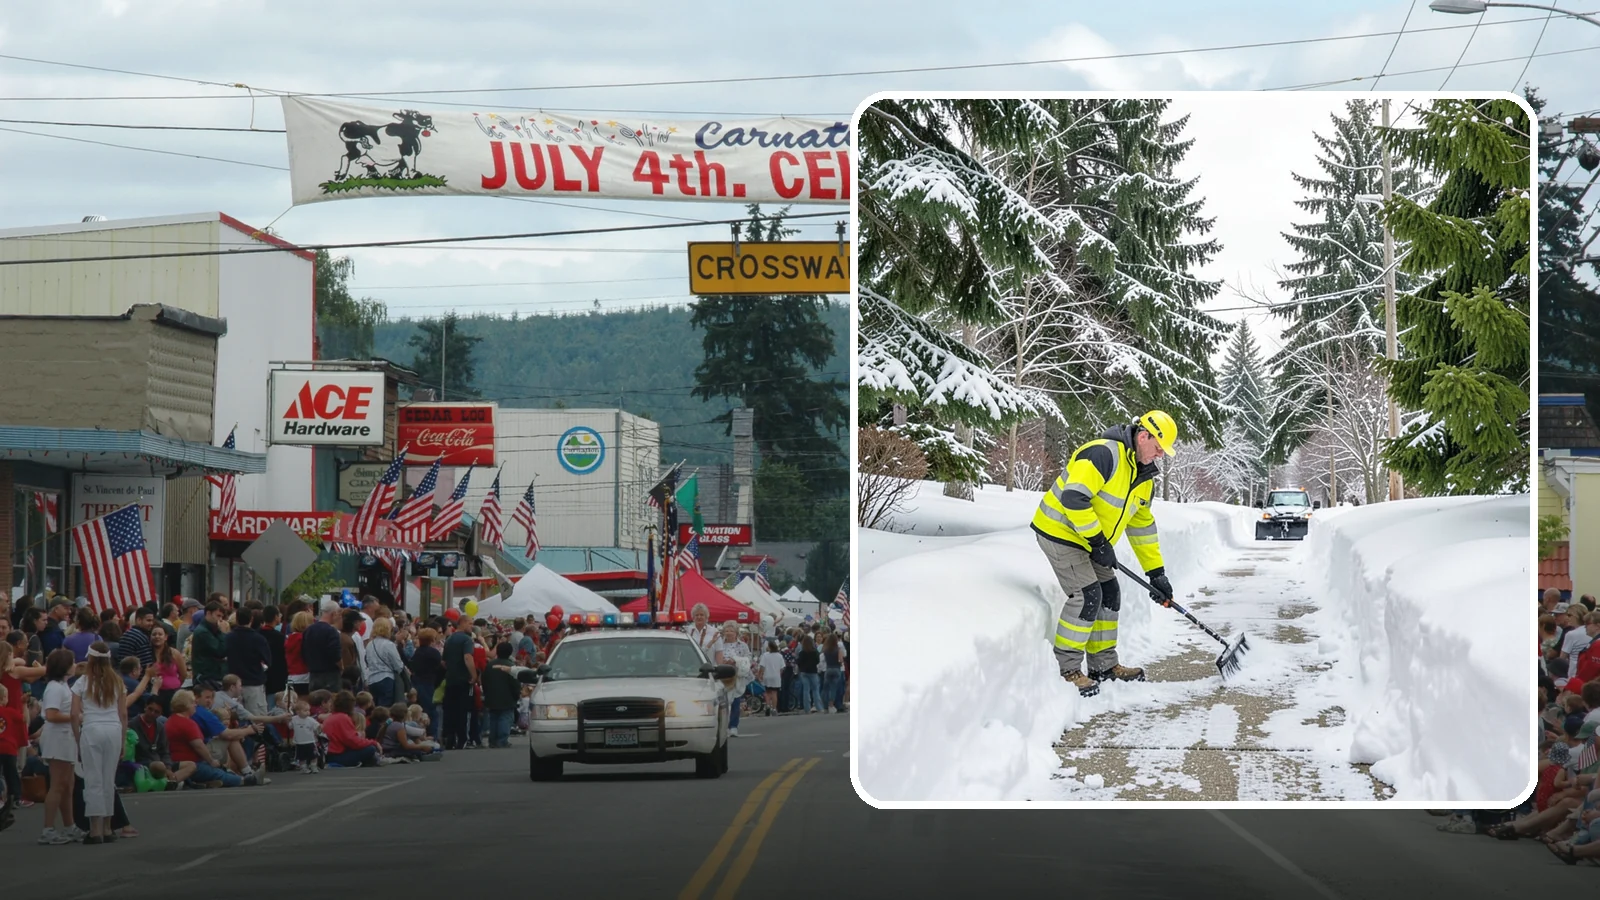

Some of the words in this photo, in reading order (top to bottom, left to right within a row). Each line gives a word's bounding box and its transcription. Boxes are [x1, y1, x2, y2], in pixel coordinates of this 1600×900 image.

[695, 121, 850, 149] Carnat
[481, 141, 605, 192] JULY
[632, 150, 746, 197] 4th.
[697, 254, 850, 280] CROSSWA
[283, 380, 373, 419] ACE
[405, 409, 452, 422] CEDAR
[284, 421, 370, 436] Hardware
[416, 428, 476, 446] Coca-Cola
[353, 467, 385, 479] Simpl
[83, 485, 94, 494] St.
[95, 485, 124, 494] Vincent
[126, 485, 136, 495] de
[137, 486, 155, 495] Paul
[81, 503, 153, 522] THT
[213, 516, 330, 535] HARDARE
[688, 526, 741, 535] CRNATION
[699, 535, 730, 543] GLASS
